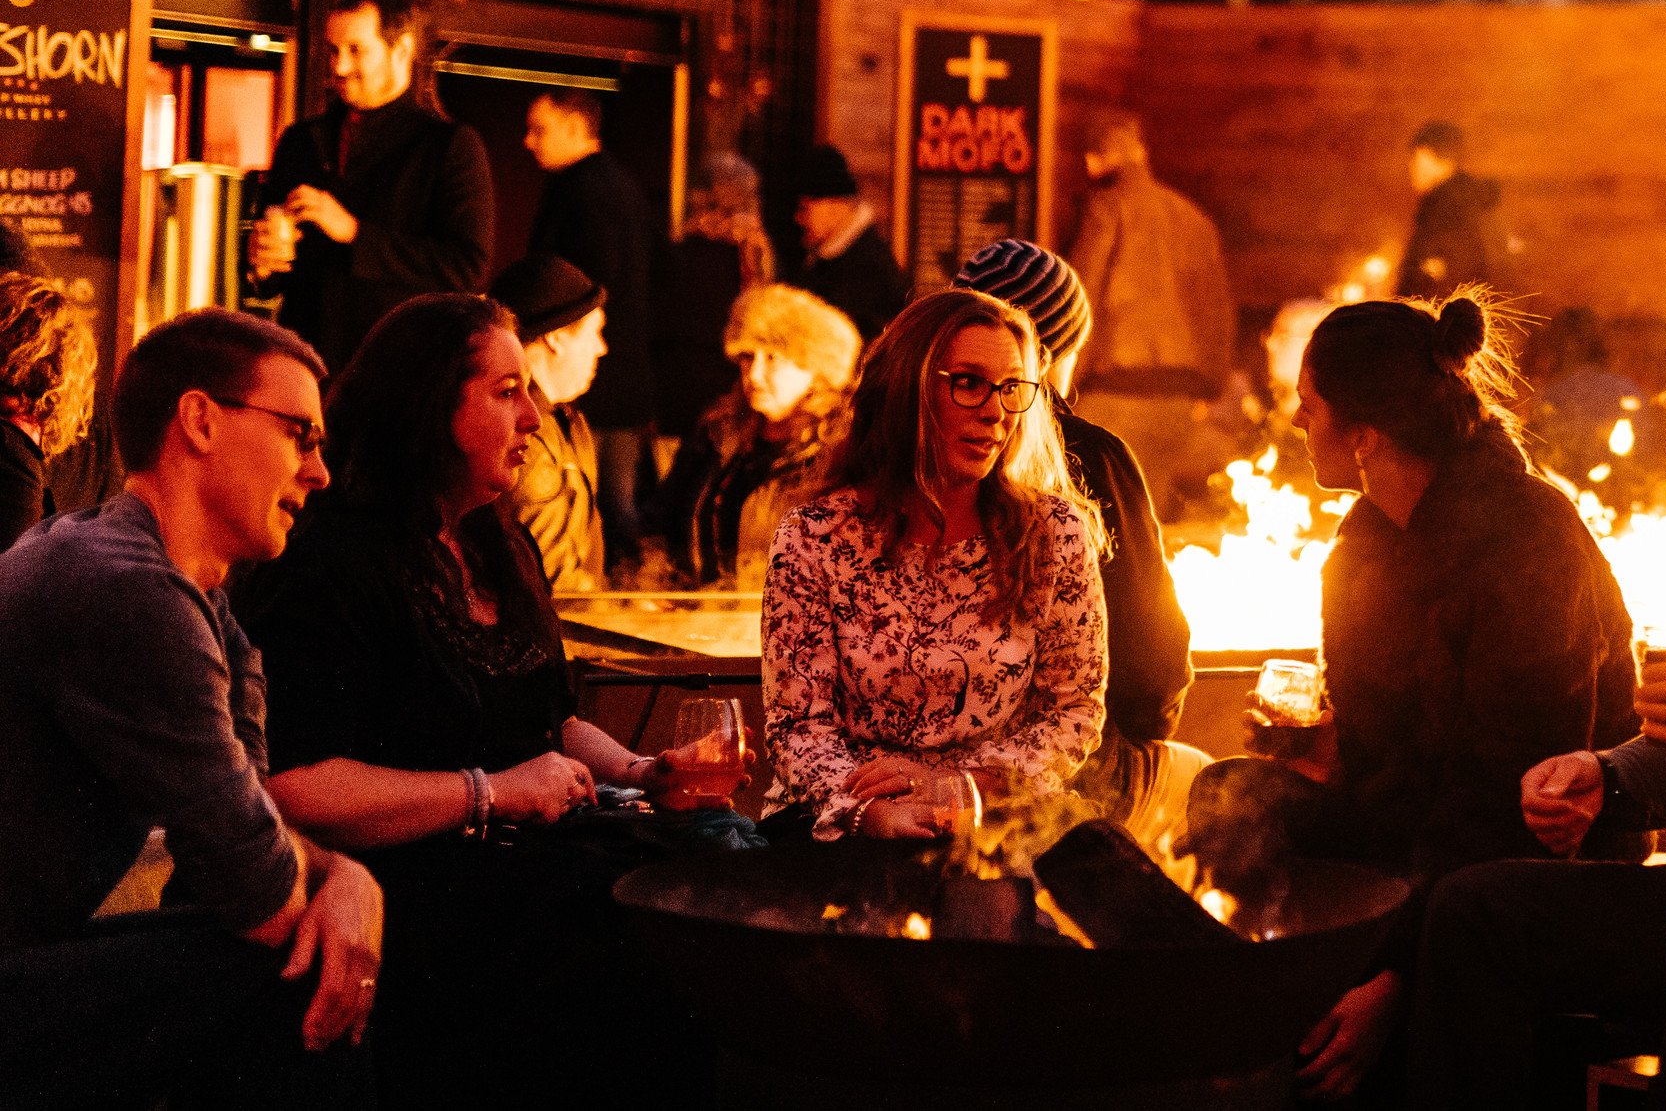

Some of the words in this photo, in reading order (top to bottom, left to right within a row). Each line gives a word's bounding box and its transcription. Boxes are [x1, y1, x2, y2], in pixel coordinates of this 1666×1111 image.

[0, 21, 128, 89] SHORN
[921, 102, 1026, 137] DARK
[917, 135, 1032, 174] MOFO
[0, 192, 66, 216] GGNOG
